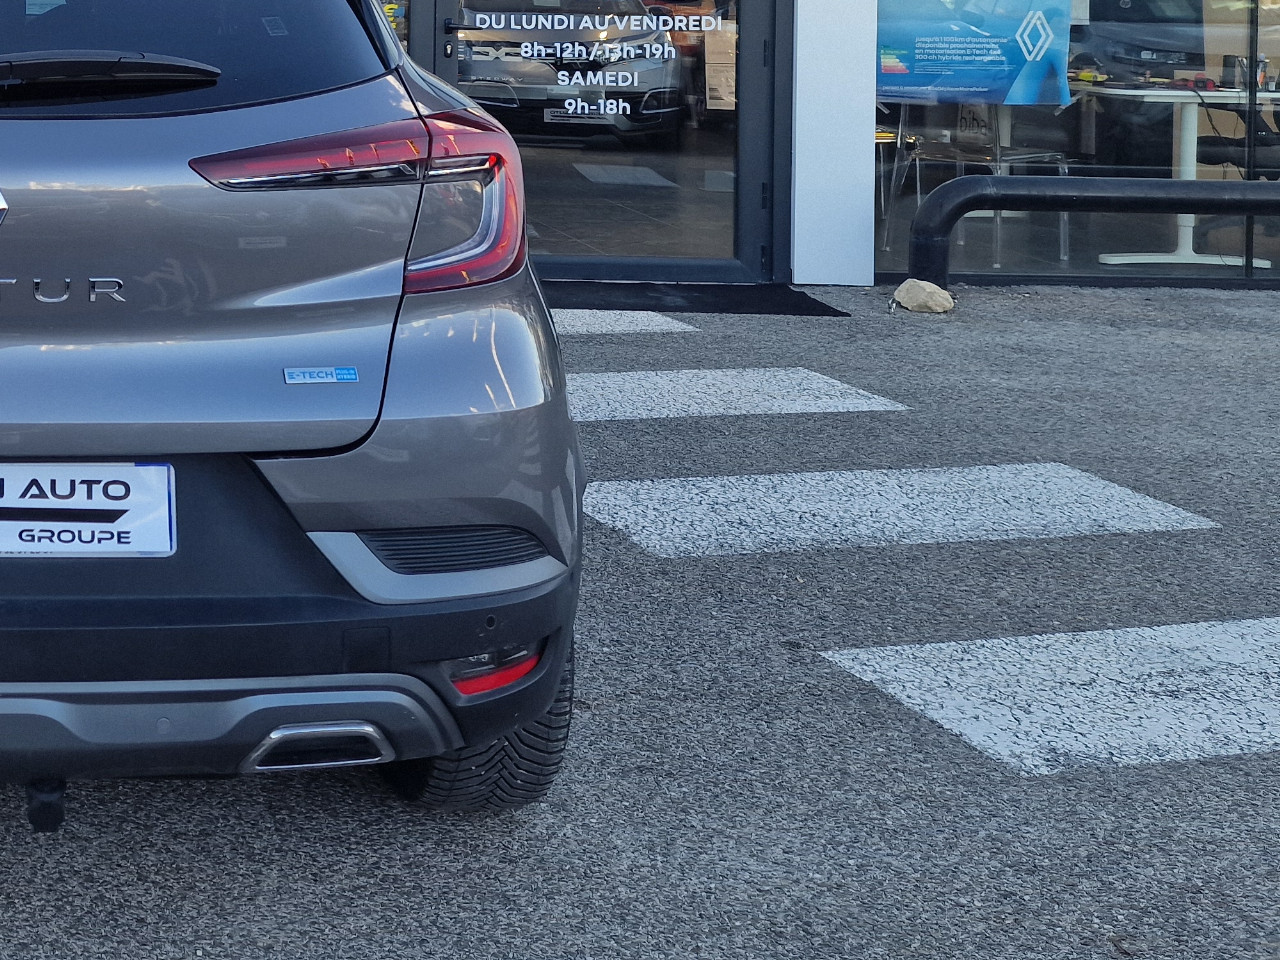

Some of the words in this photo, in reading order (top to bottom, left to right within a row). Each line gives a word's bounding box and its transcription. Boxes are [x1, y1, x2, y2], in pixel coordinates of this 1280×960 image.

[476, 14, 506, 29] DU
[510, 14, 575, 30] LUNDI
[578, 15, 610, 30] AU
[614, 15, 722, 31] VENDREDI
[520, 42, 587, 59] 8h-12h
[557, 71, 639, 87] SAMEDI
[564, 98, 631, 115] 9h-18h
[287, 370, 334, 380] E-TECH
[18, 477, 131, 501] AUTO
[18, 528, 132, 545] GROUPE
